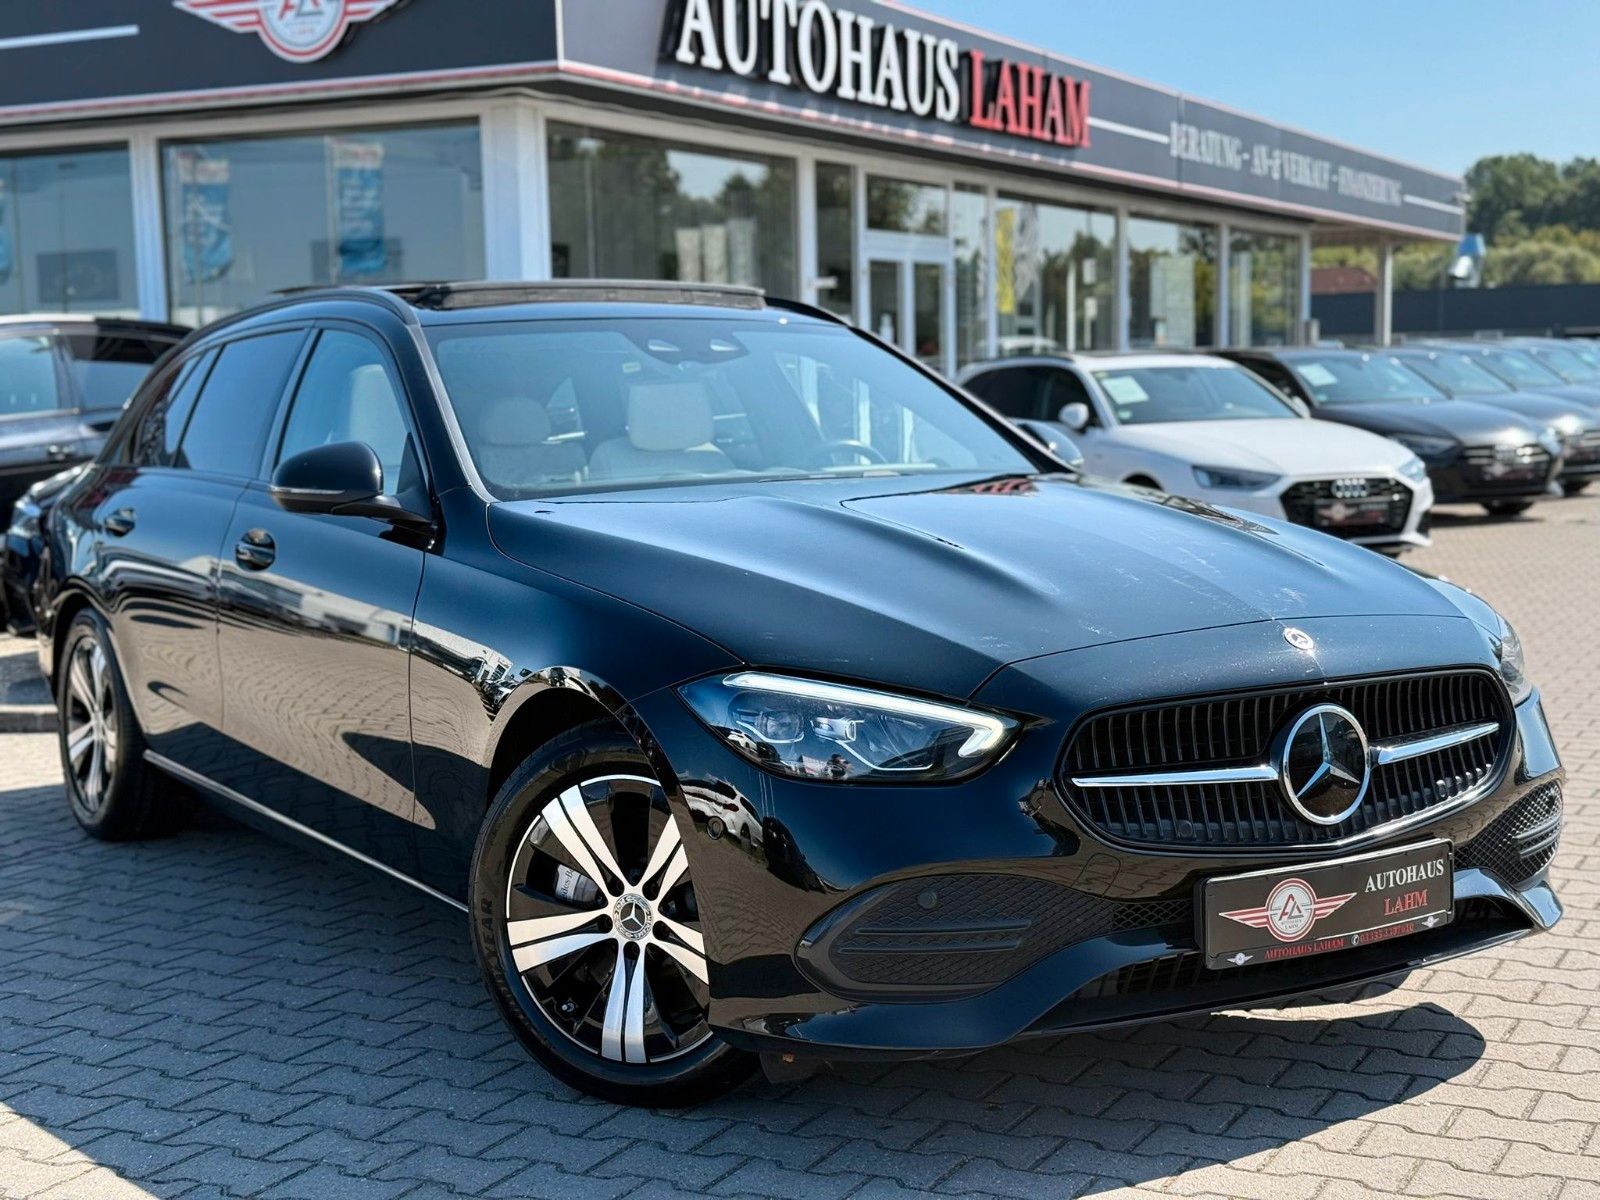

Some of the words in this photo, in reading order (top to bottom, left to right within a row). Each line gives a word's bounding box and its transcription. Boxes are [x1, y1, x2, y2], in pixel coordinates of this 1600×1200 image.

[676, 0, 959, 122] AUTOHAUS
[969, 49, 1090, 148] LAHAM
[1365, 859, 1444, 892] AUTOHAUS
[1384, 889, 1428, 916] LAHM
[1264, 945, 1312, 960] AUTOHAUS
